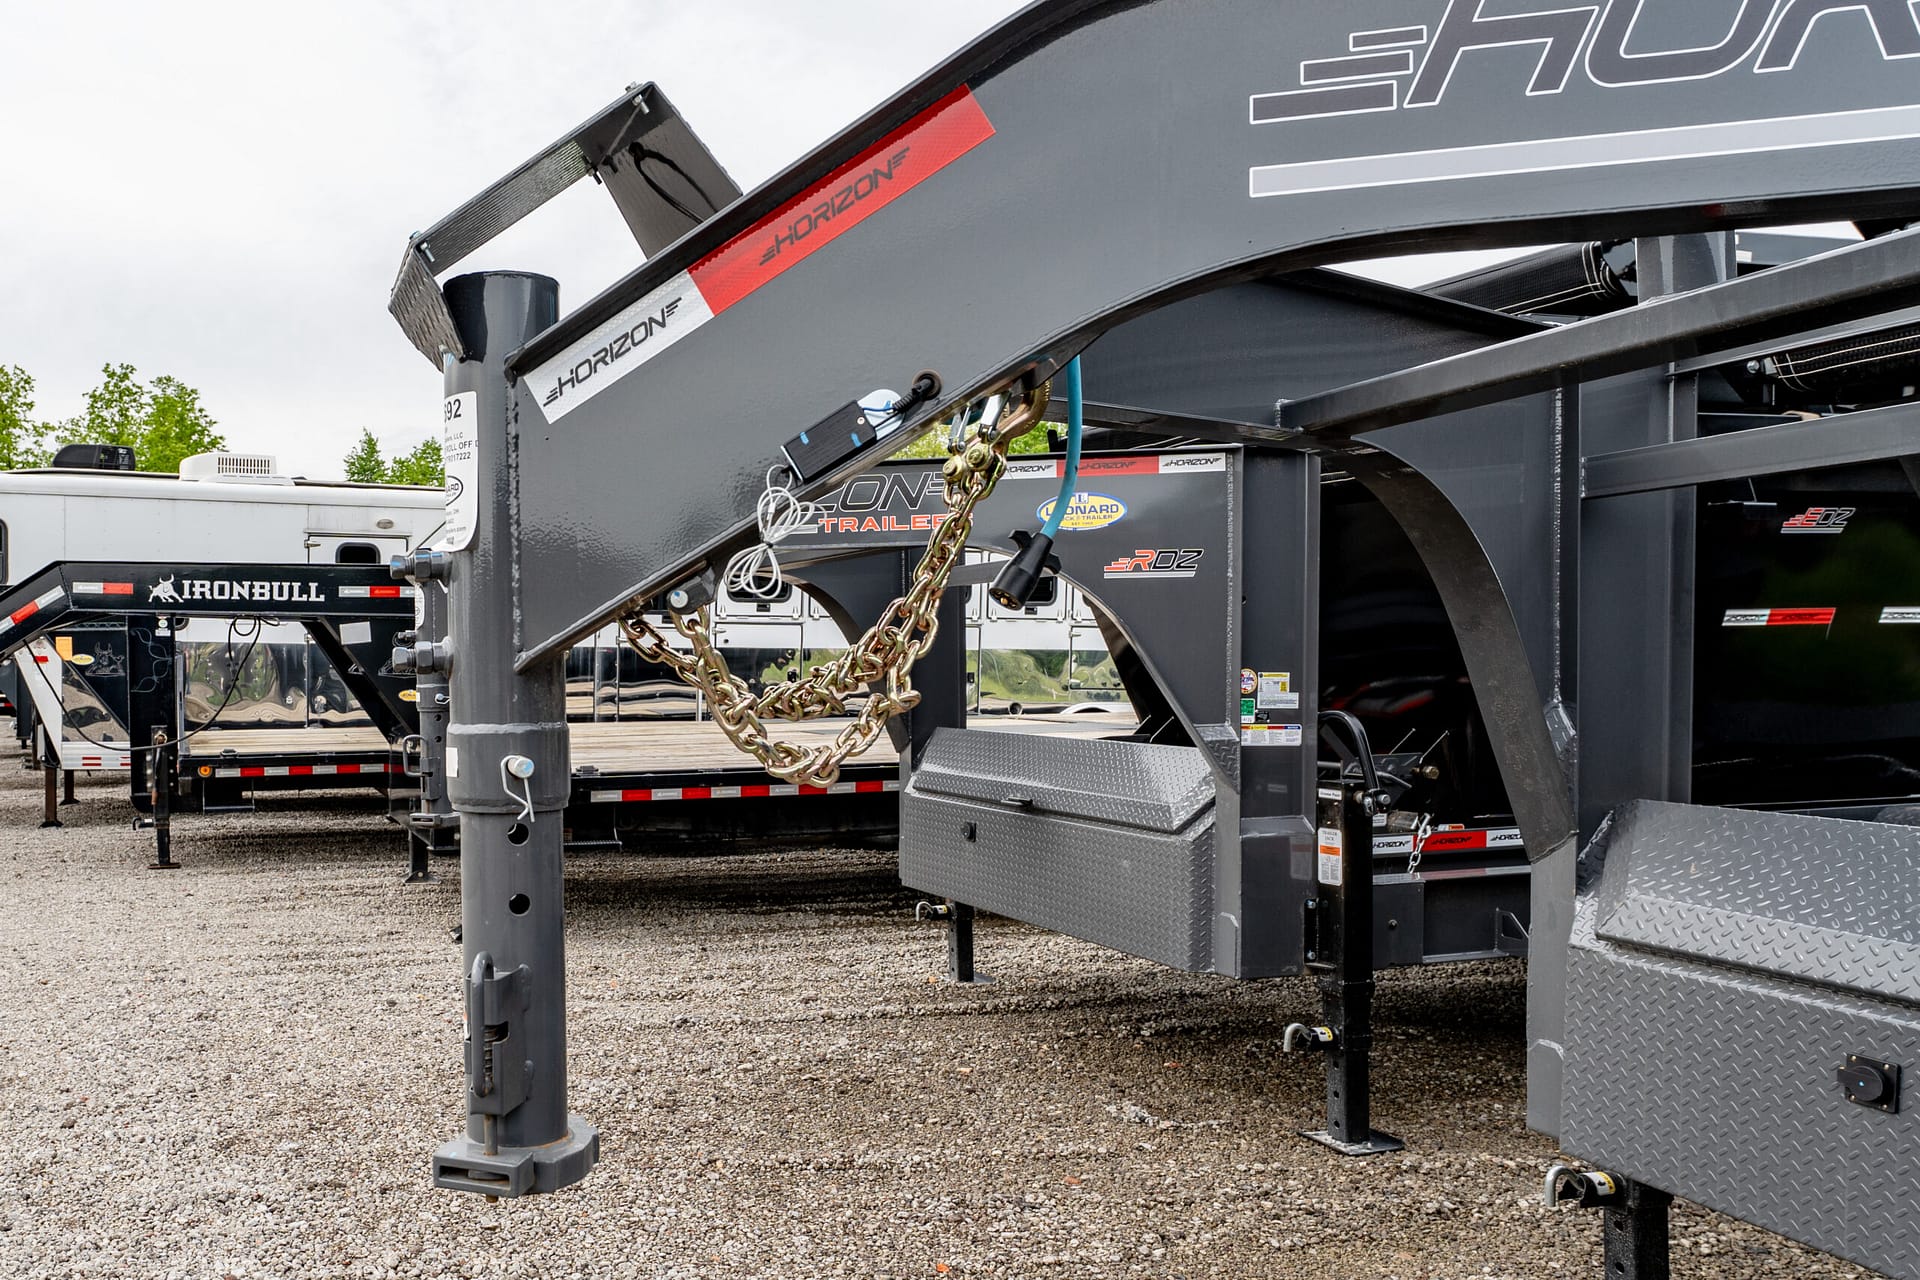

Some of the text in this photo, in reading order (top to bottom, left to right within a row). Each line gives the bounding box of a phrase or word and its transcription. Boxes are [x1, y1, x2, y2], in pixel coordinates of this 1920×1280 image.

[768, 157, 900, 258] HORIZON
[551, 304, 674, 401] HORIZON
[445, 399, 462, 422] 92
[1166, 457, 1217, 467] HORIZON
[1045, 503, 1119, 516] LONARD
[818, 514, 974, 534] TRAILE
[1122, 549, 1205, 572] RDZ
[182, 579, 325, 602] IRONBULL
